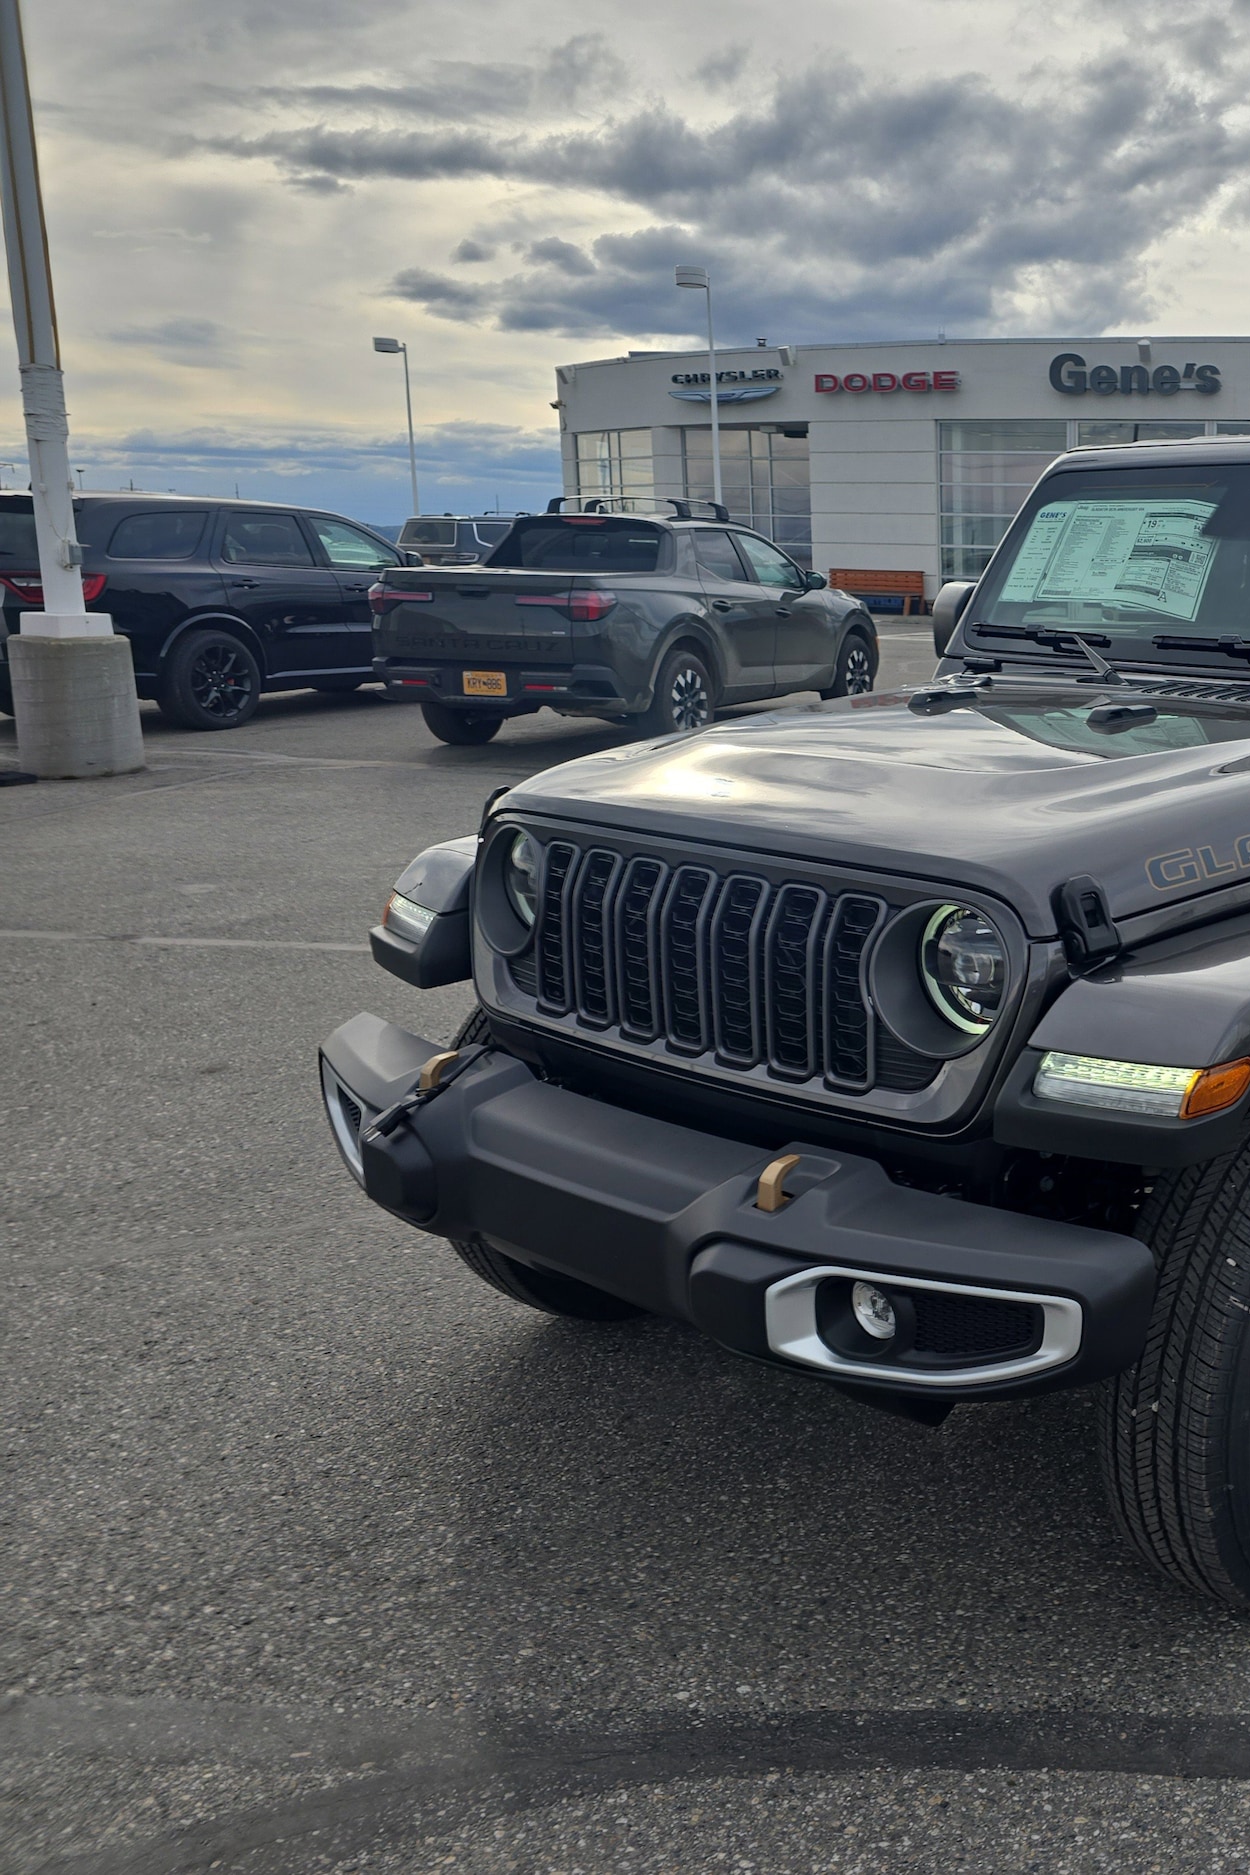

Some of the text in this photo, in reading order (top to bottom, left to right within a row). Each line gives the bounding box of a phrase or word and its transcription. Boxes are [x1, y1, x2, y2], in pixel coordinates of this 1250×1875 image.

[814, 370, 960, 393] DODGE
[1049, 352, 1222, 396] Gene's
[1040, 511, 1067, 519] GENE'S
[395, 635, 560, 652] SANTA CRUZ
